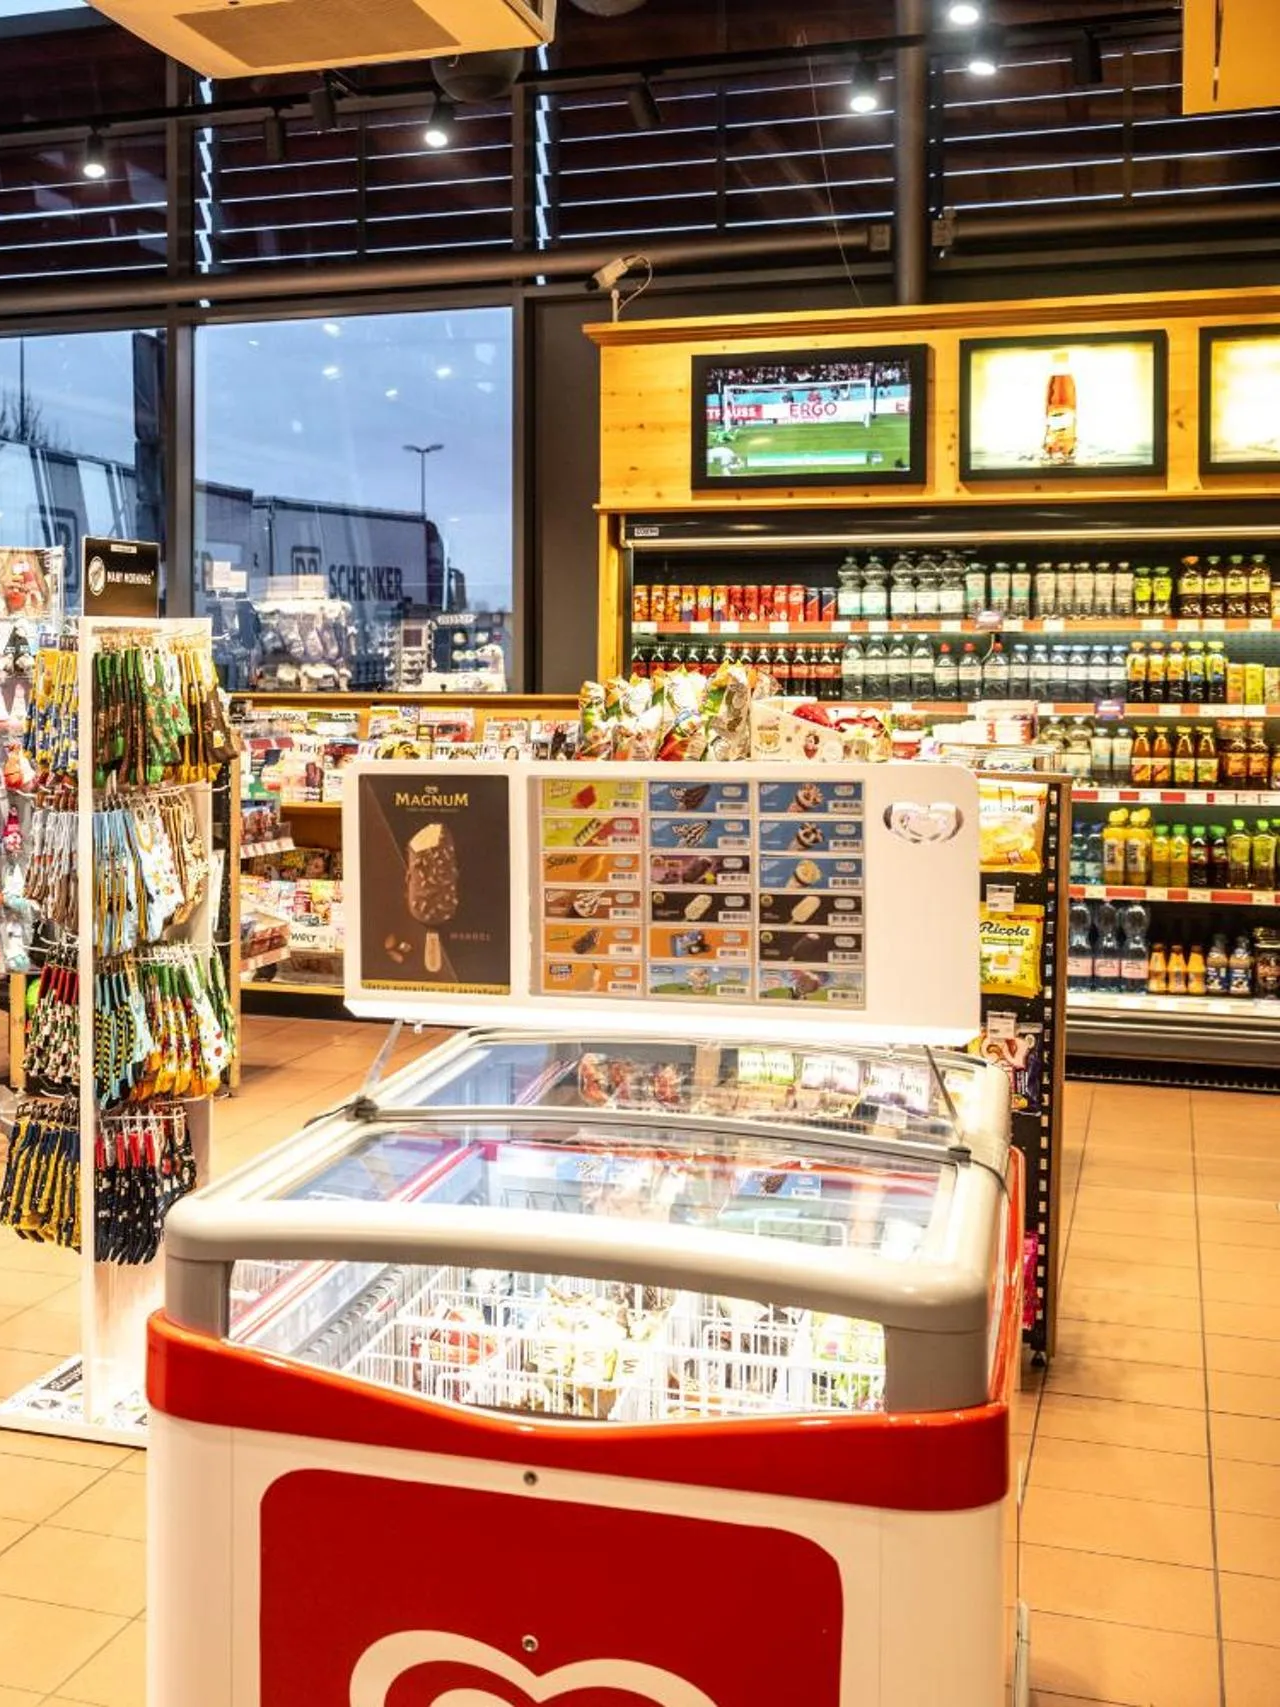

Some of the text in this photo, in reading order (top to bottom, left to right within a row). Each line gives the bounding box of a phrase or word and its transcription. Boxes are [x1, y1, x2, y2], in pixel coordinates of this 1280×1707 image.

[789, 402, 837, 418] ERGO
[328, 564, 403, 601] SCHENKER
[394, 791, 469, 807] MAGNUM
[979, 921, 1030, 937] Ricola
